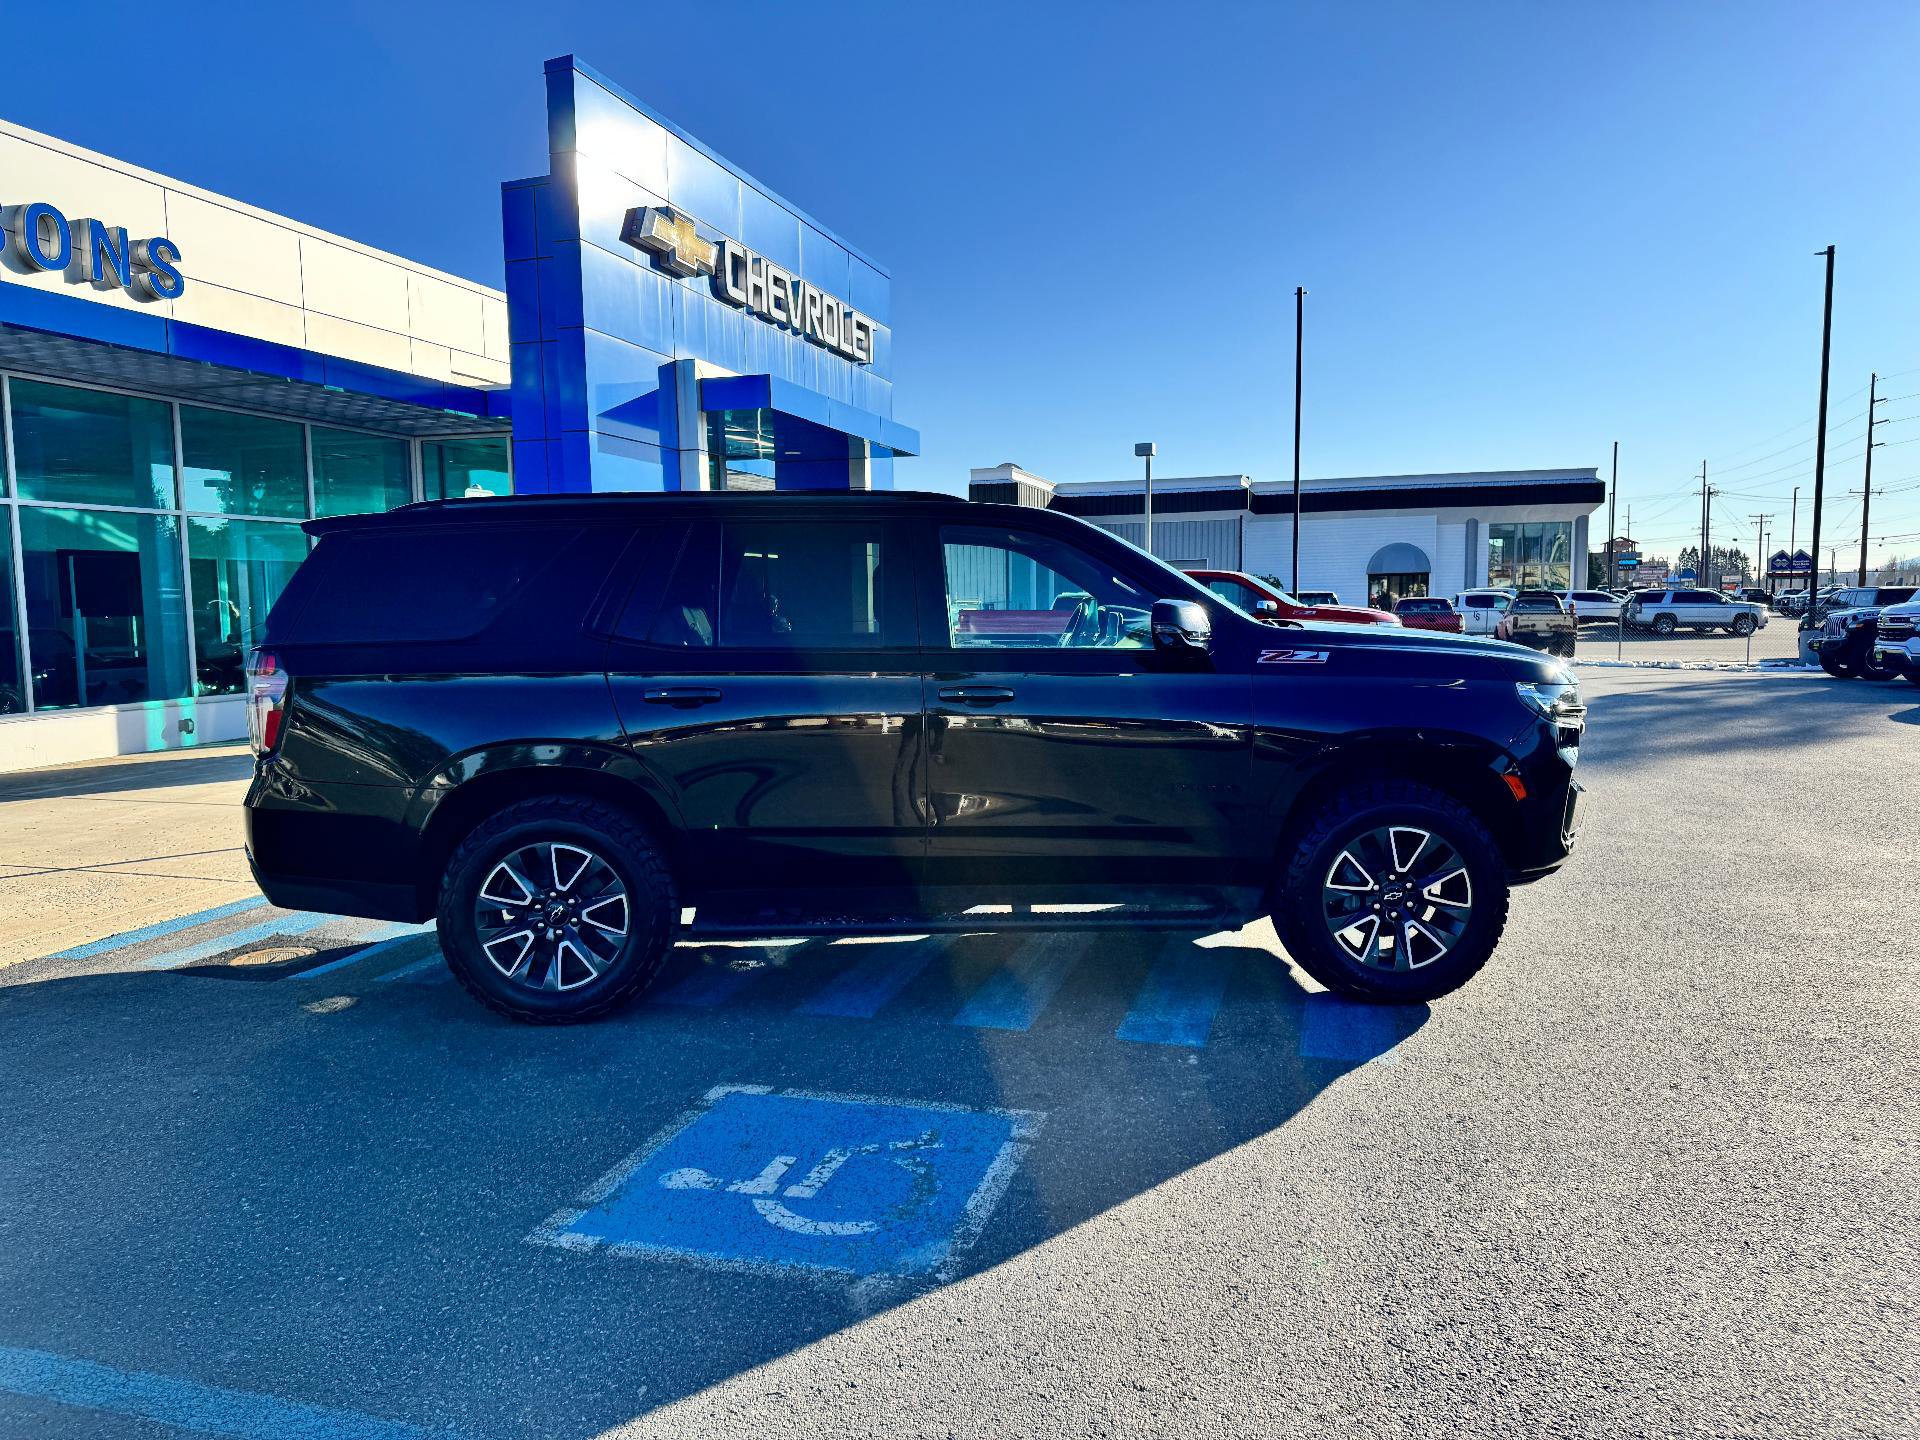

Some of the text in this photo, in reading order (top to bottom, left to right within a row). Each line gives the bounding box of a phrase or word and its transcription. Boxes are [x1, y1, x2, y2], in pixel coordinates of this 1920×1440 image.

[0, 202, 185, 300] ONS
[720, 239, 878, 366] CHEVROLET
[1256, 649, 1331, 664] Z71
